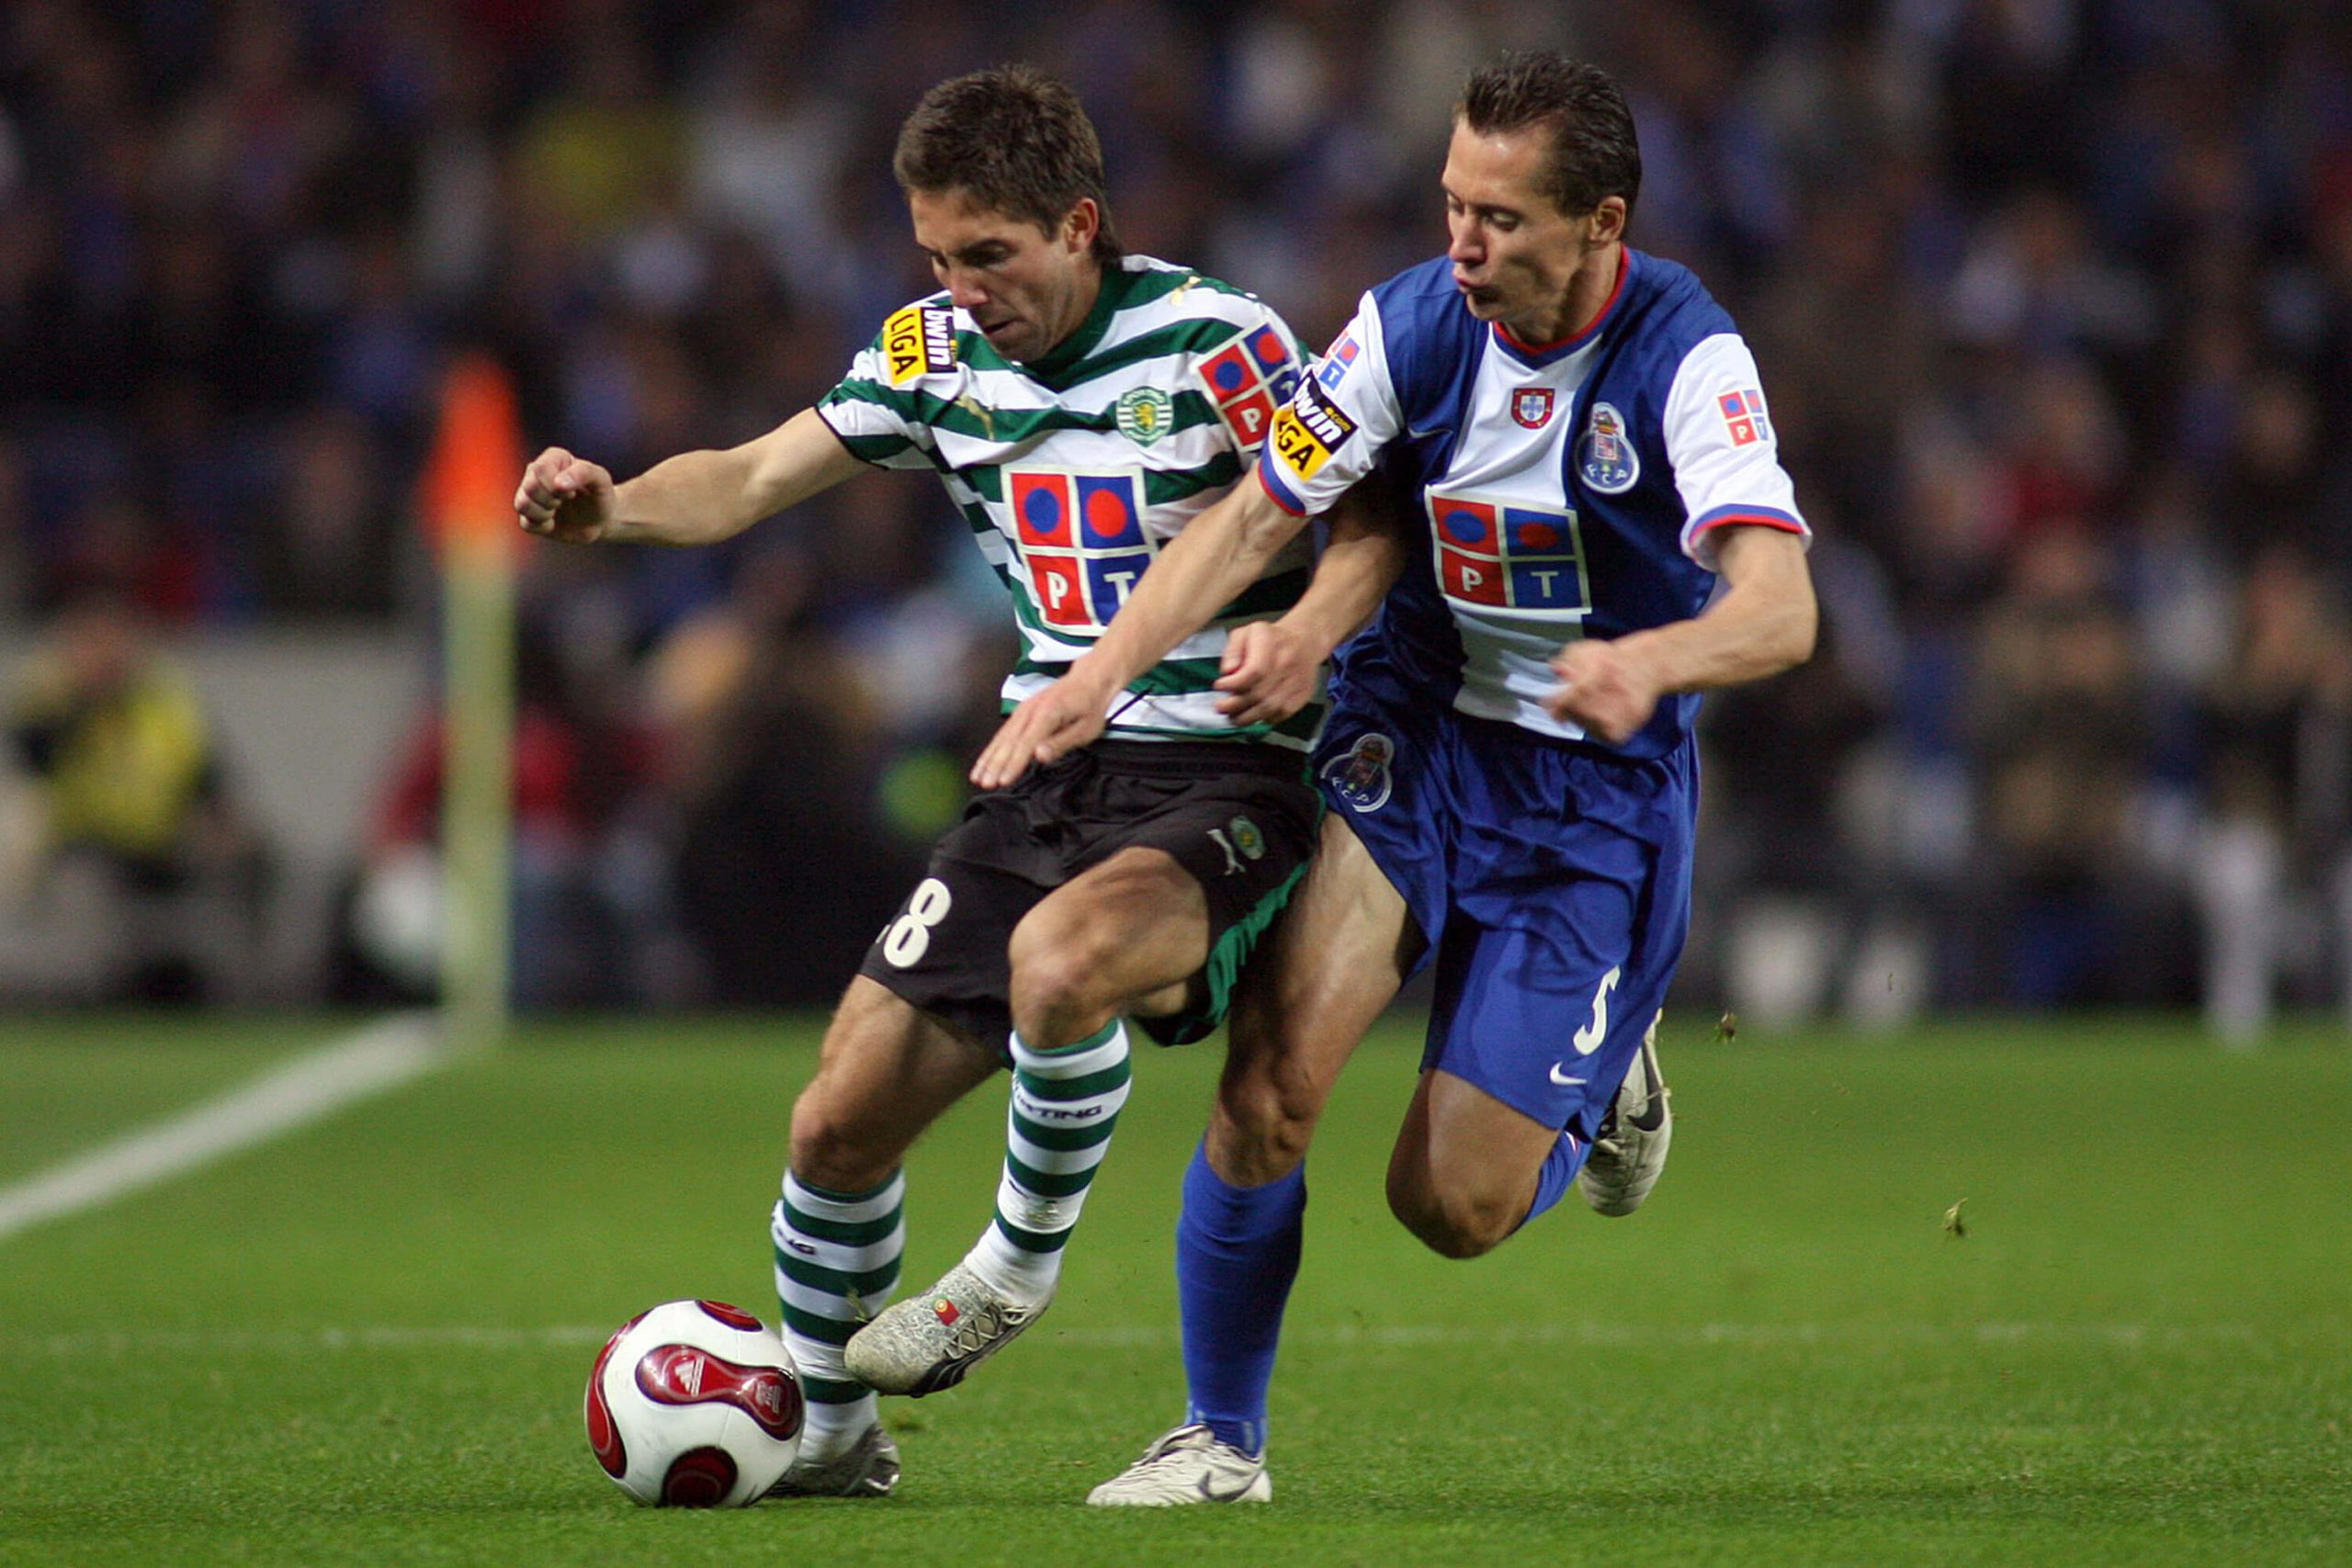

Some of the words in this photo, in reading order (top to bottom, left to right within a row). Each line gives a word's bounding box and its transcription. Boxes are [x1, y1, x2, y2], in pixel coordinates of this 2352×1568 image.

[890, 313, 918, 376] LIGA
[1241, 408, 1261, 433] P
[1736, 425, 1748, 440] P
[1046, 570, 1069, 610] P
[1103, 571, 1136, 609] T
[1461, 565, 1484, 592] P
[1530, 570, 1559, 598] T
[876, 877, 953, 968] 8
